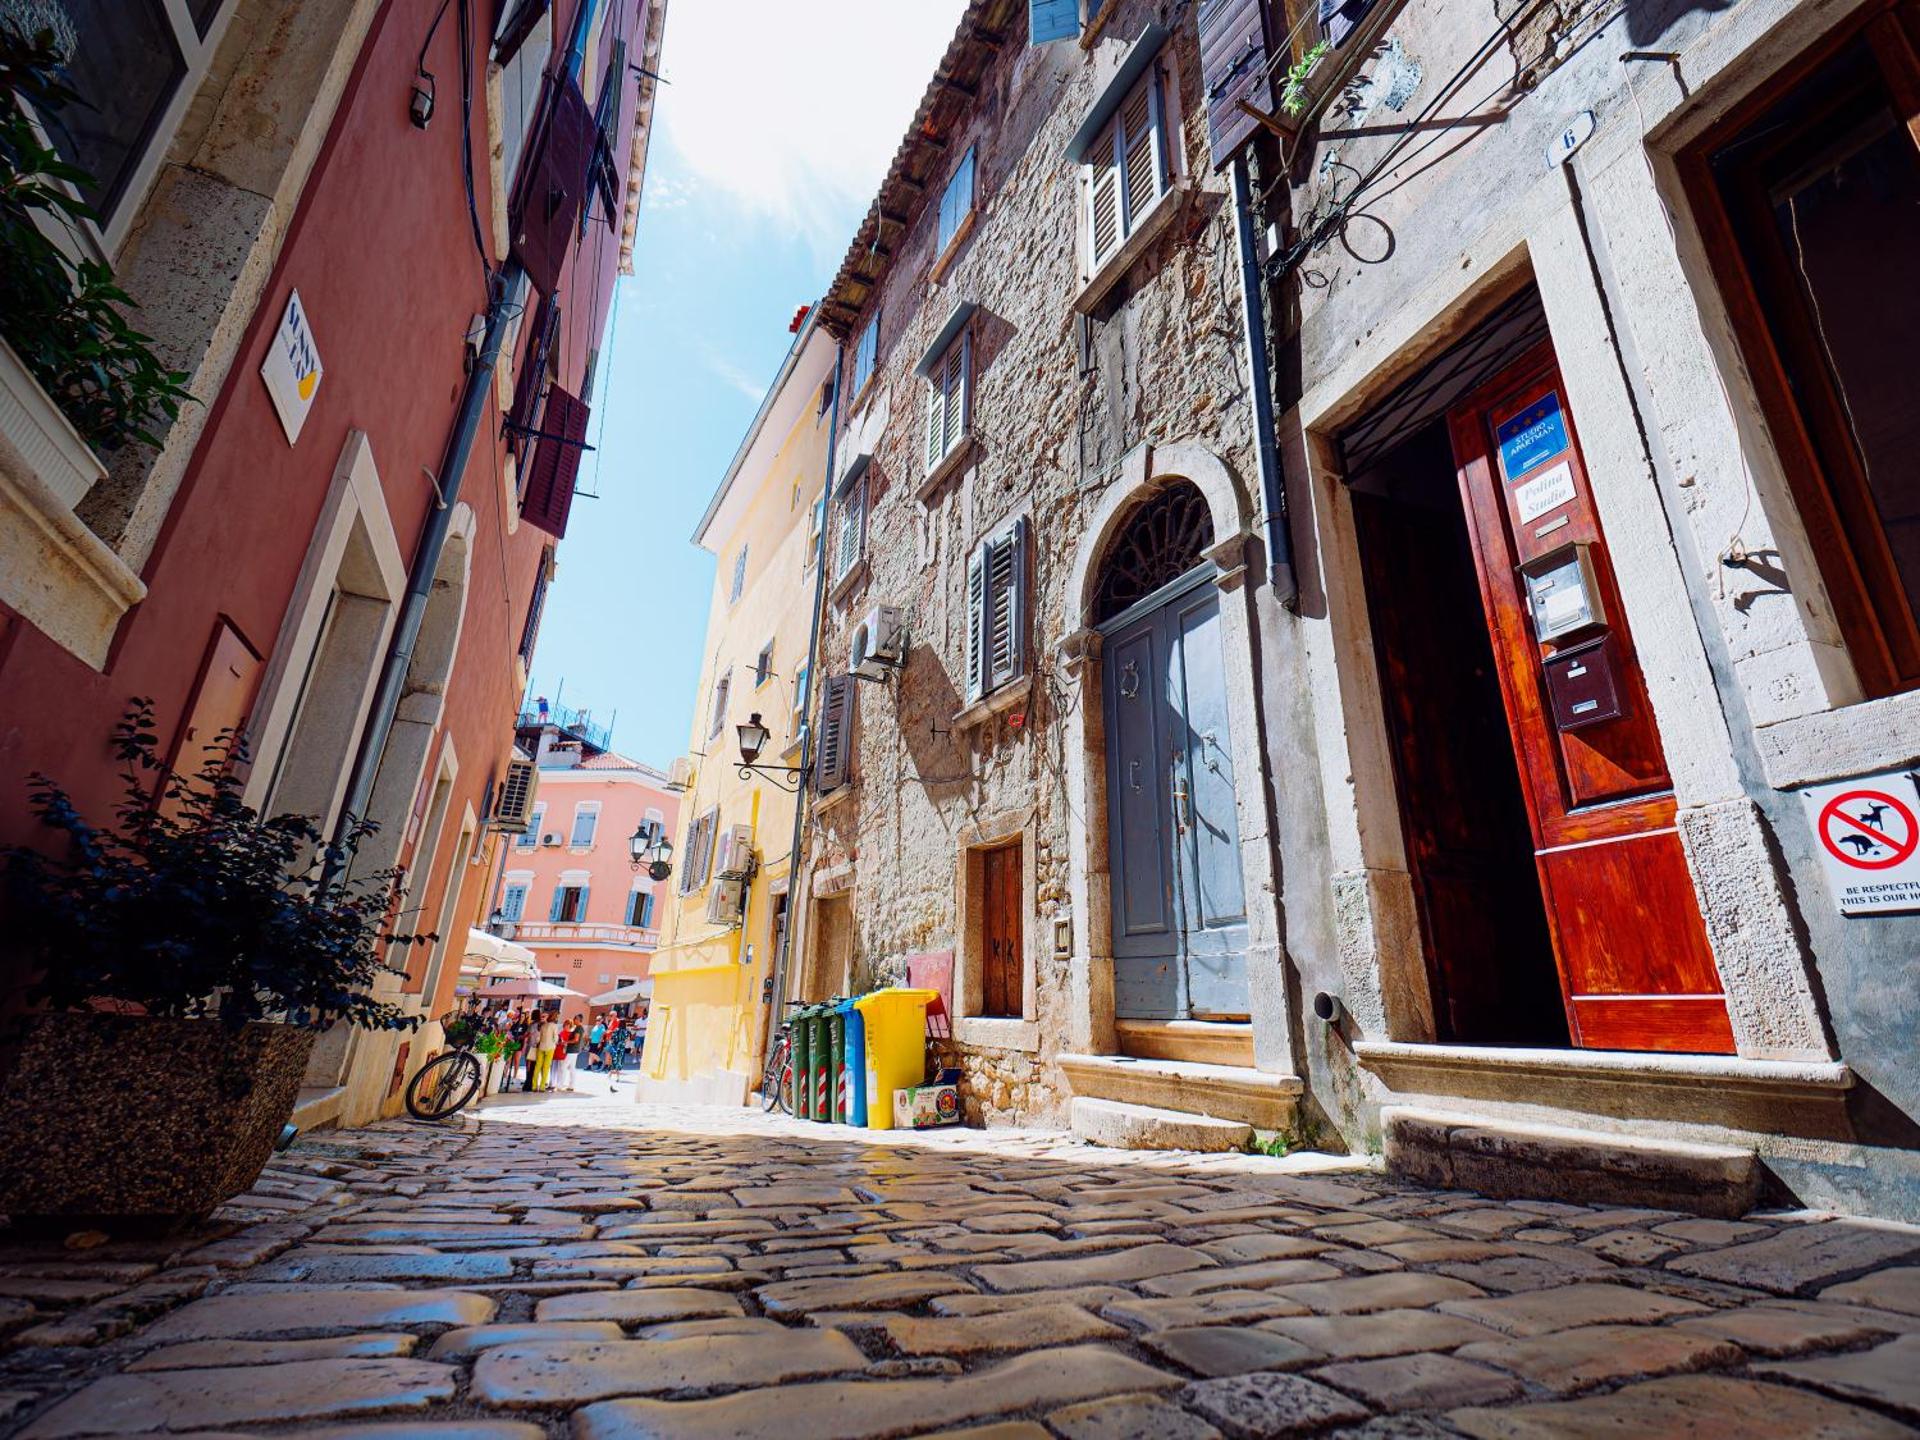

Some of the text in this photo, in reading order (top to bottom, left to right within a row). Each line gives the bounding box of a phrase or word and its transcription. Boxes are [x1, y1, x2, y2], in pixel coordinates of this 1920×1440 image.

[1563, 128, 1576, 149] 6
[1510, 423, 1555, 456] APARTMAN
[1515, 422, 1546, 446] STUDIO
[1525, 472, 1564, 501] Polina
[1527, 488, 1567, 515] Studio
[1840, 891, 1920, 905] THIS IS OUR H
[1846, 886, 1860, 895] BE
